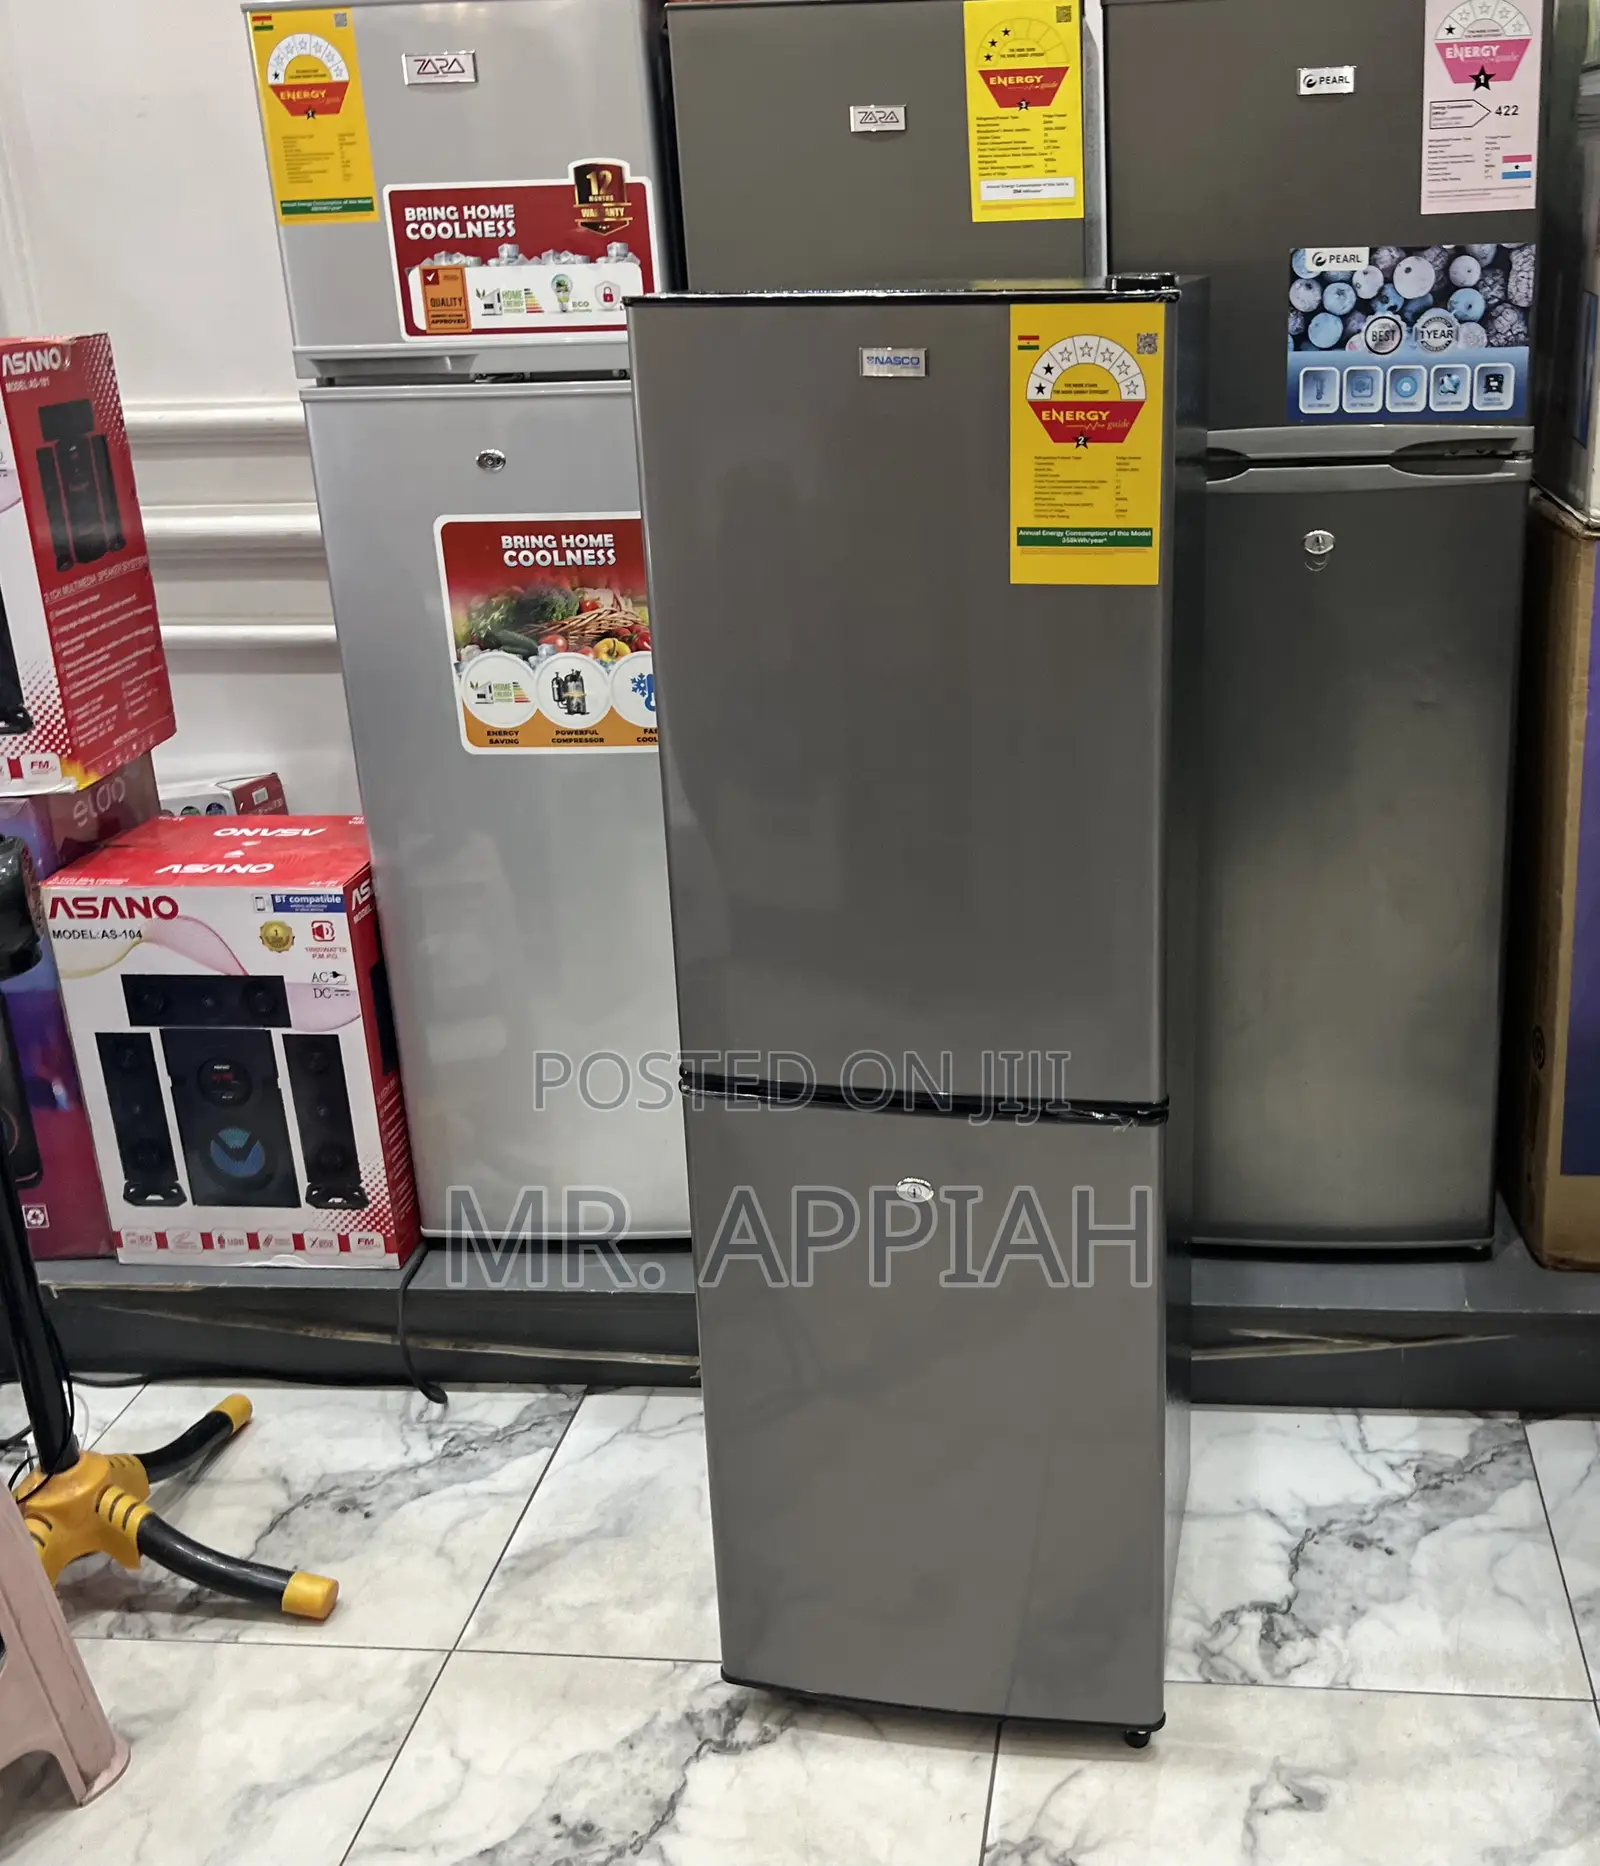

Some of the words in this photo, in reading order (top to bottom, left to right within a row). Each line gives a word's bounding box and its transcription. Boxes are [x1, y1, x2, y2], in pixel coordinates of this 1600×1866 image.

[1445, 45, 1500, 61] ENERGY
[413, 58, 465, 75] ZARA
[989, 75, 1044, 87] ENERGY
[1319, 76, 1351, 84] PEARL
[1479, 75, 1485, 83] 1
[280, 90, 326, 101] ENERGY
[1494, 105, 1519, 116] 422
[858, 110, 900, 124] ZARA
[586, 170, 613, 195] 12
[404, 206, 459, 222] BRING
[462, 204, 515, 220] HOME
[406, 220, 516, 240] COOLNESS
[1328, 254, 1363, 264] PEARL
[429, 297, 463, 307] QUALITY
[1371, 330, 1396, 341] BEST
[1426, 330, 1454, 339] YEAR
[2, 347, 62, 377] ASANO
[875, 356, 920, 366] NASCO
[1041, 408, 1110, 424] ENERGY
[1107, 419, 1130, 430] guide
[1078, 436, 1085, 444] 2
[501, 535, 557, 549] BRING
[561, 534, 615, 548] HOME
[503, 549, 616, 567] COOLNESS
[30, 760, 50, 769] FM
[213, 827, 329, 837] ASANO
[155, 863, 275, 874] ASANO
[275, 895, 286, 903] BT
[289, 894, 342, 905] compatible
[49, 895, 179, 920] ASANO
[311, 972, 329, 983] AC
[313, 988, 332, 999] DC
[357, 1237, 375, 1246] FM
